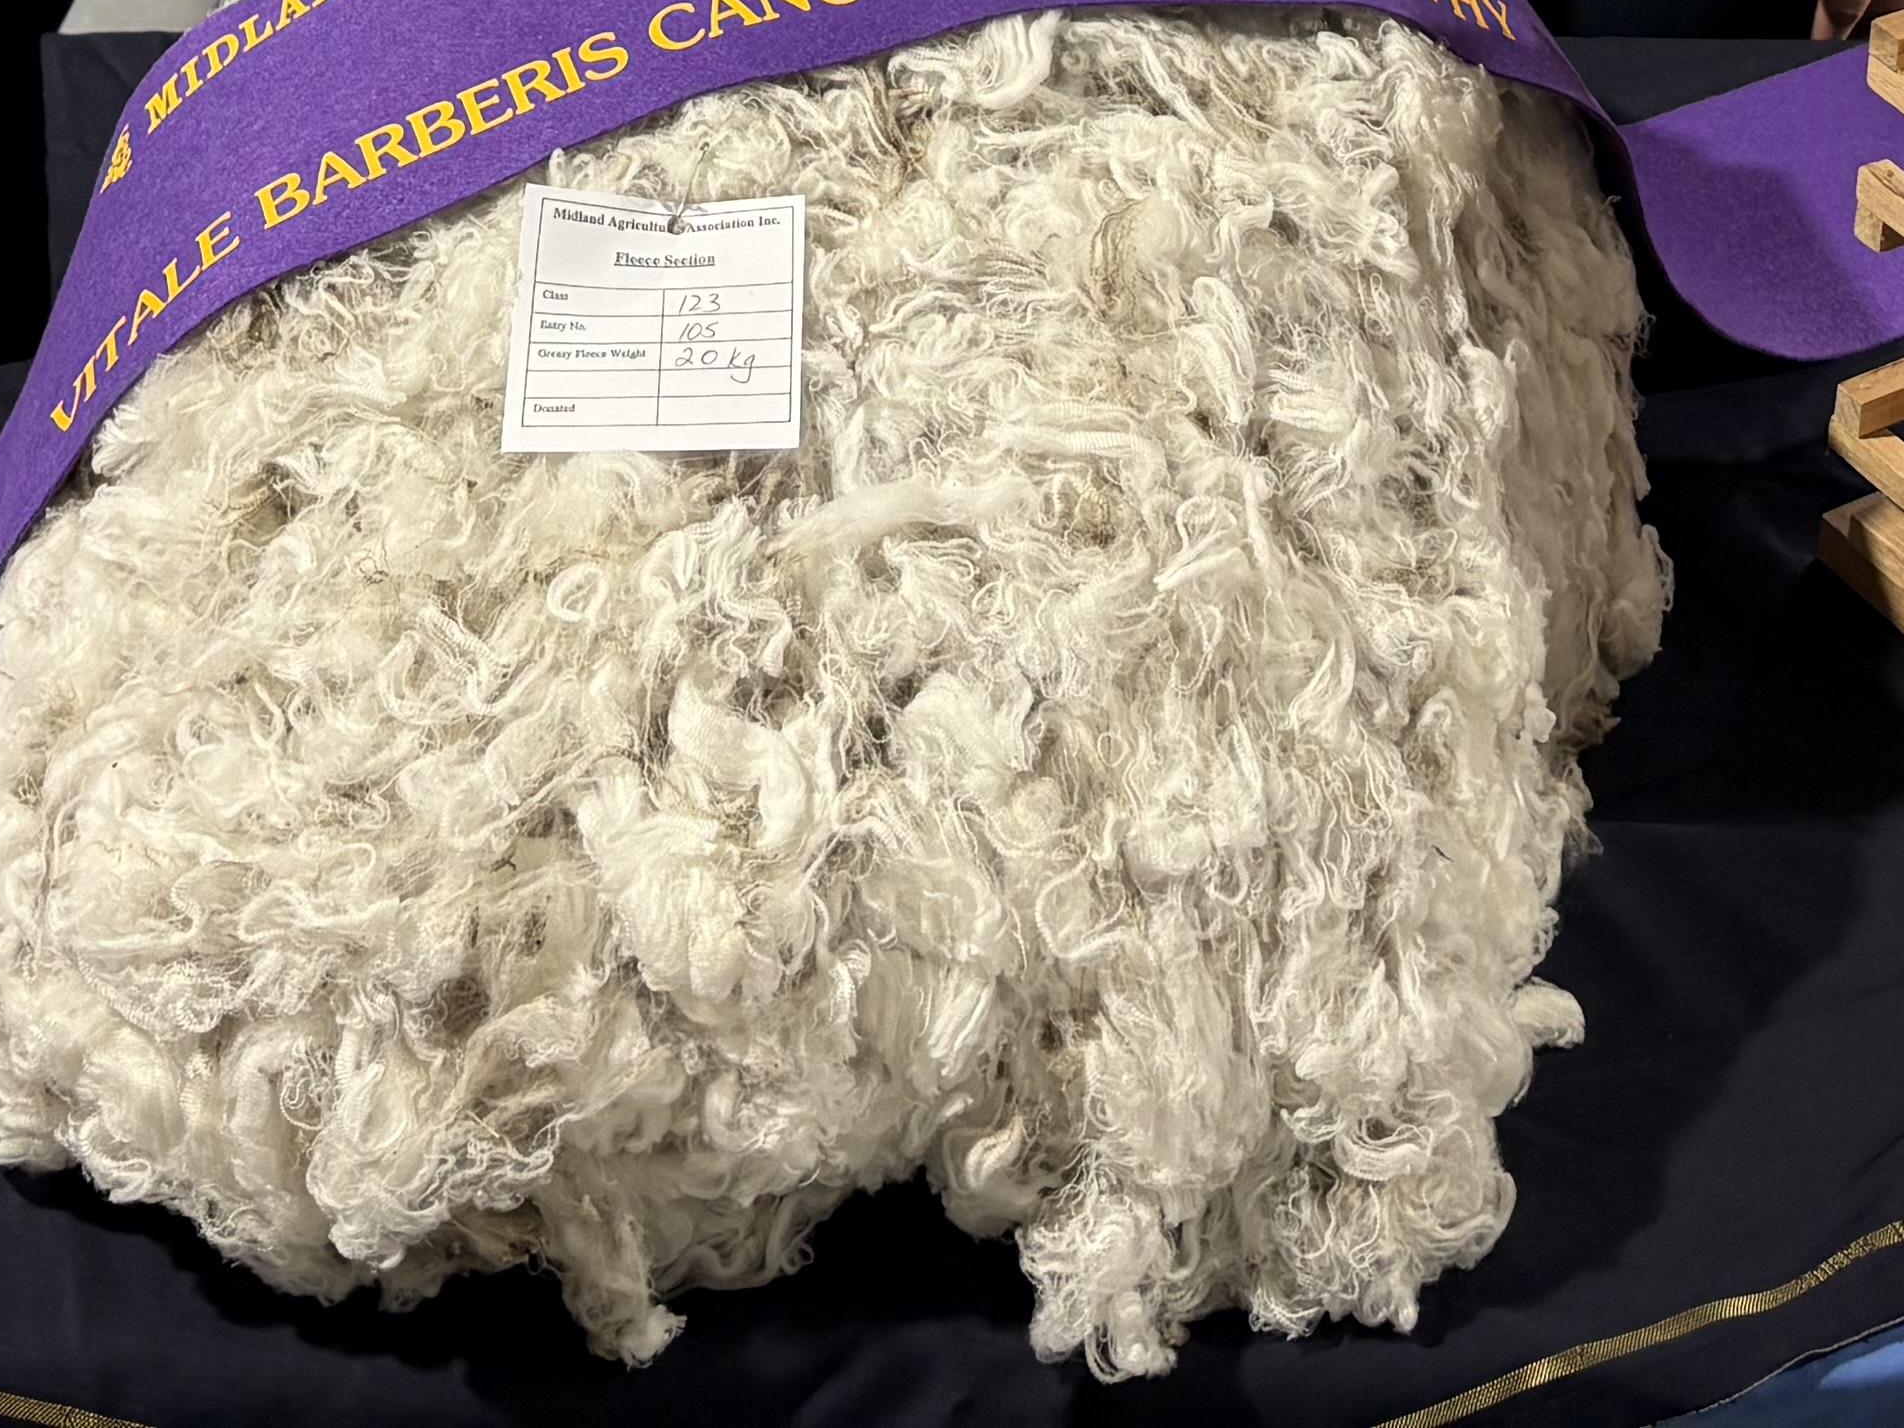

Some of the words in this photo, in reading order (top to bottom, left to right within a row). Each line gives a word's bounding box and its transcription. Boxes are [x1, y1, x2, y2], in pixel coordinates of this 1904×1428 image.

[553, 207, 605, 227] Midland
[607, 215, 676, 233] Agricultu
[686, 217, 755, 233] Association
[758, 216, 781, 228] Inc.
[49, 210, 241, 433] VITALE
[253, 31, 631, 232] BARBERIS
[614, 252, 660, 266] Fleece
[664, 254, 715, 267] Section
[542, 290, 569, 301] Class
[678, 293, 722, 315] 123
[540, 320, 567, 332] Entry
[678, 321, 720, 342] 105
[538, 349, 572, 360] Greasy
[610, 348, 646, 360] Weight
